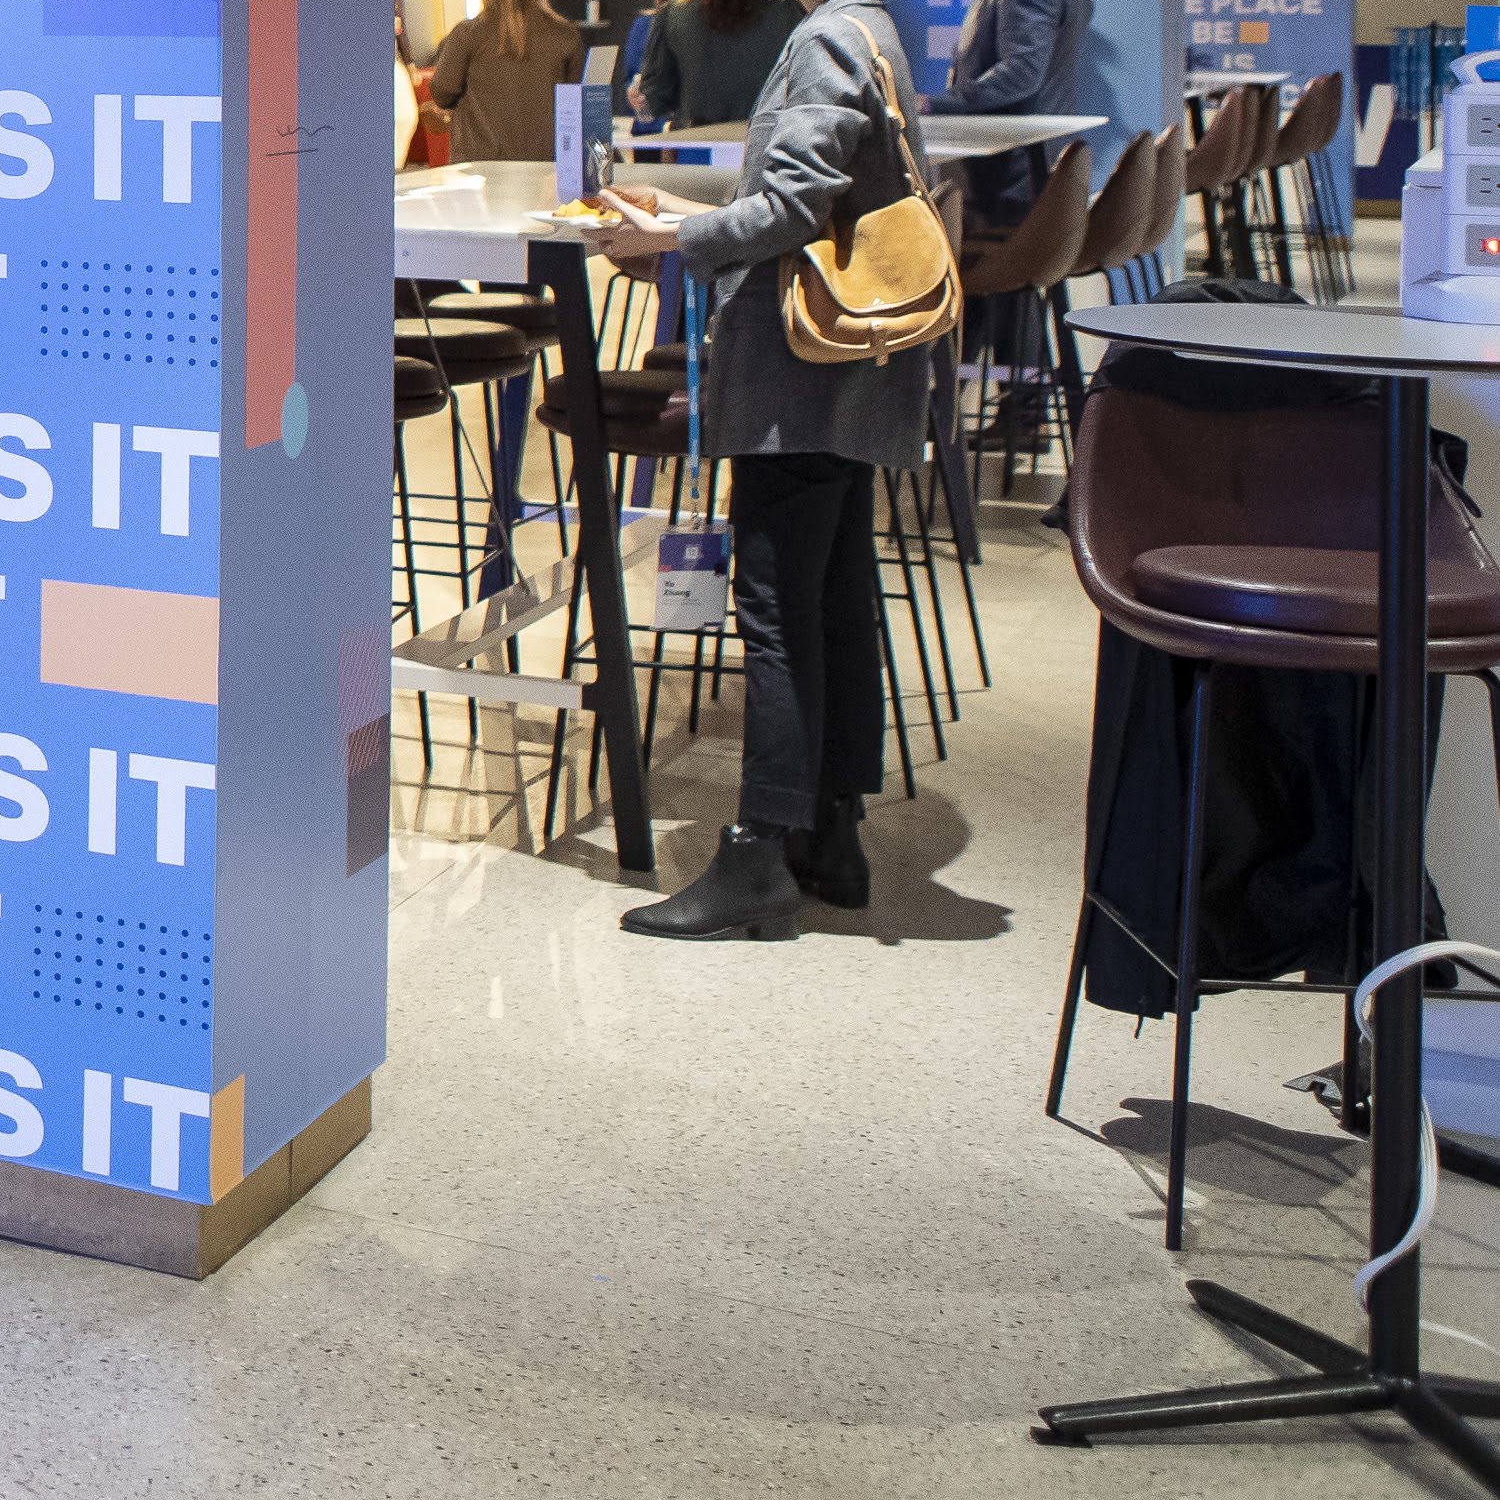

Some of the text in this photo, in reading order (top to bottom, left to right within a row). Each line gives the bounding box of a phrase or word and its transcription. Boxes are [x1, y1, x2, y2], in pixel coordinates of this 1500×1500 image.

[1192, 21, 1234, 44] BE
[94, 94, 221, 204] IT
[92, 423, 219, 536] IT
[88, 747, 215, 866] IT
[83, 1069, 210, 1192] IT
